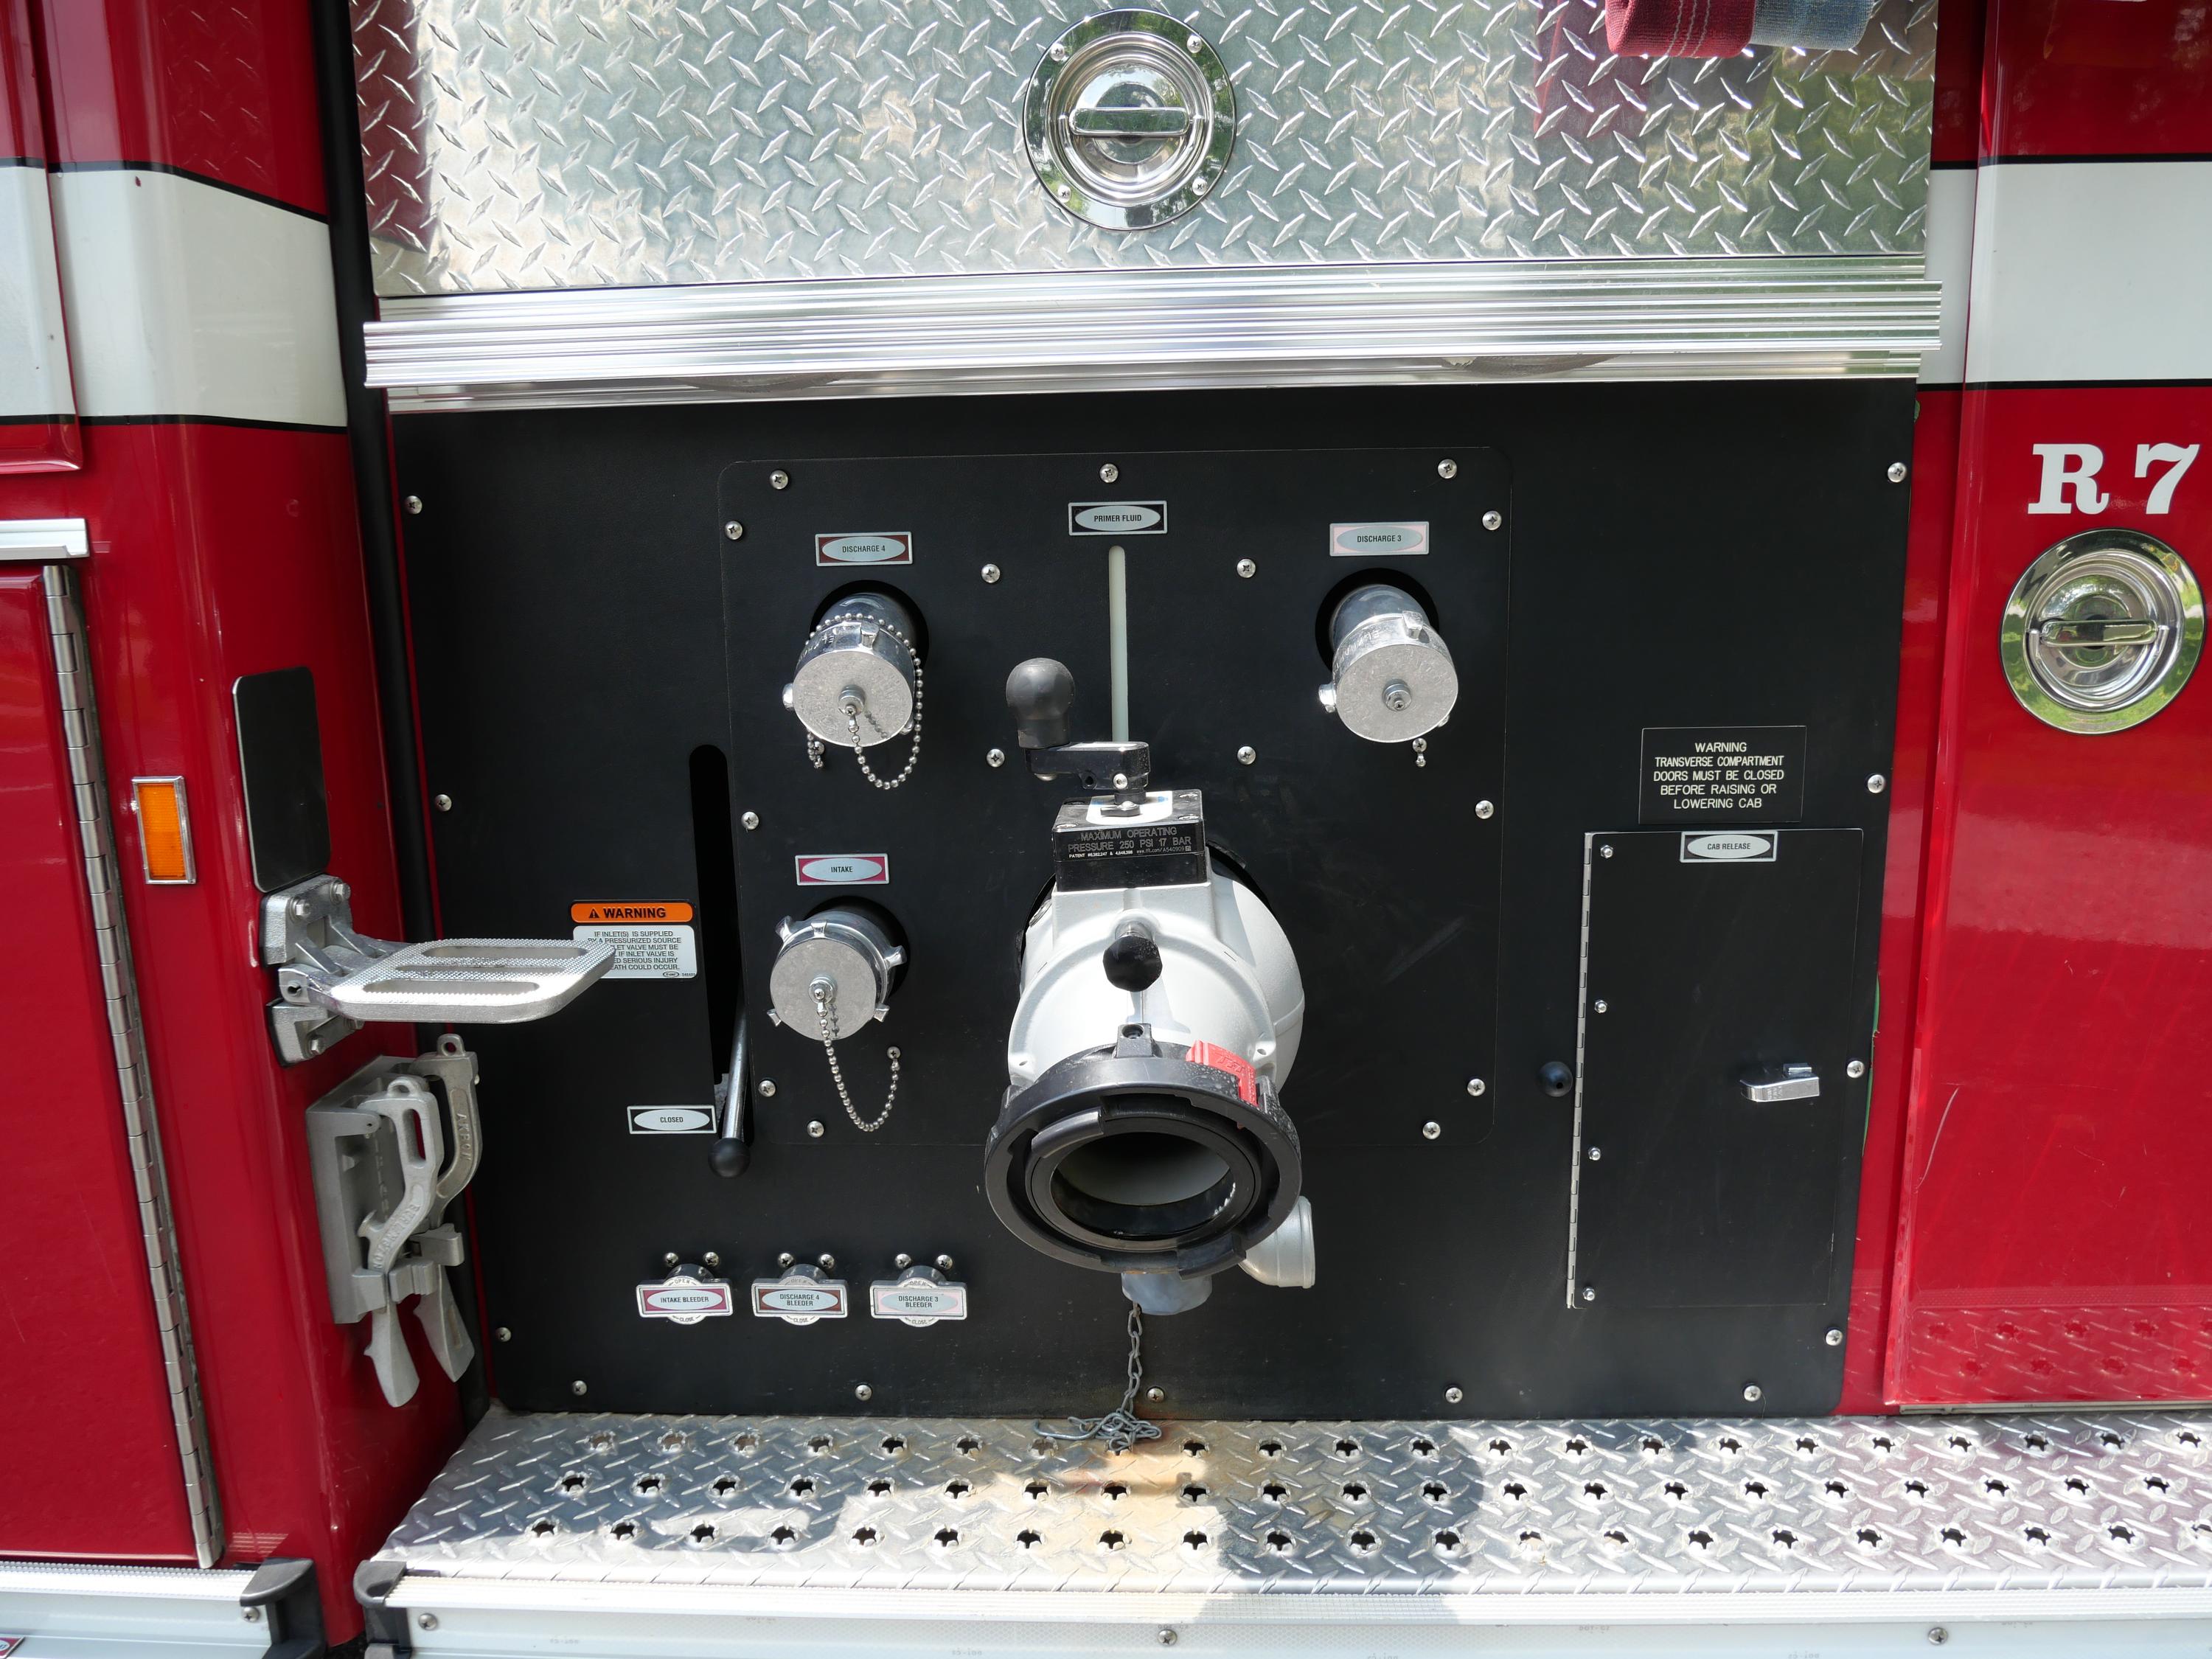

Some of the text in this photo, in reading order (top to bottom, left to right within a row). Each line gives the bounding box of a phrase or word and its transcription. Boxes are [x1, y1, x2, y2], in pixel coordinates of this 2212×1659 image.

[2028, 442, 2200, 515] R 7
[1122, 514, 1142, 522] FLUID
[1357, 535, 1396, 543] DISCHARGE
[842, 545, 880, 553] DISCHARGE
[1695, 742, 1747, 752] WARNING
[1655, 755, 1784, 767] TRANSVERSE COMPARTMENT
[1653, 770, 1784, 782] DOORS MUST BE CLOSED
[1660, 784, 1777, 795] BEFORE RAISING OR
[1674, 798, 1762, 809] LOWERING CAB
[1080, 827, 1178, 841] MAXIMUM OPERATING
[1068, 836, 1192, 853] PRESSURE 250 PSI 17 BAR
[603, 908, 667, 919] WARNING
[456, 1113, 472, 1162] AKRON
